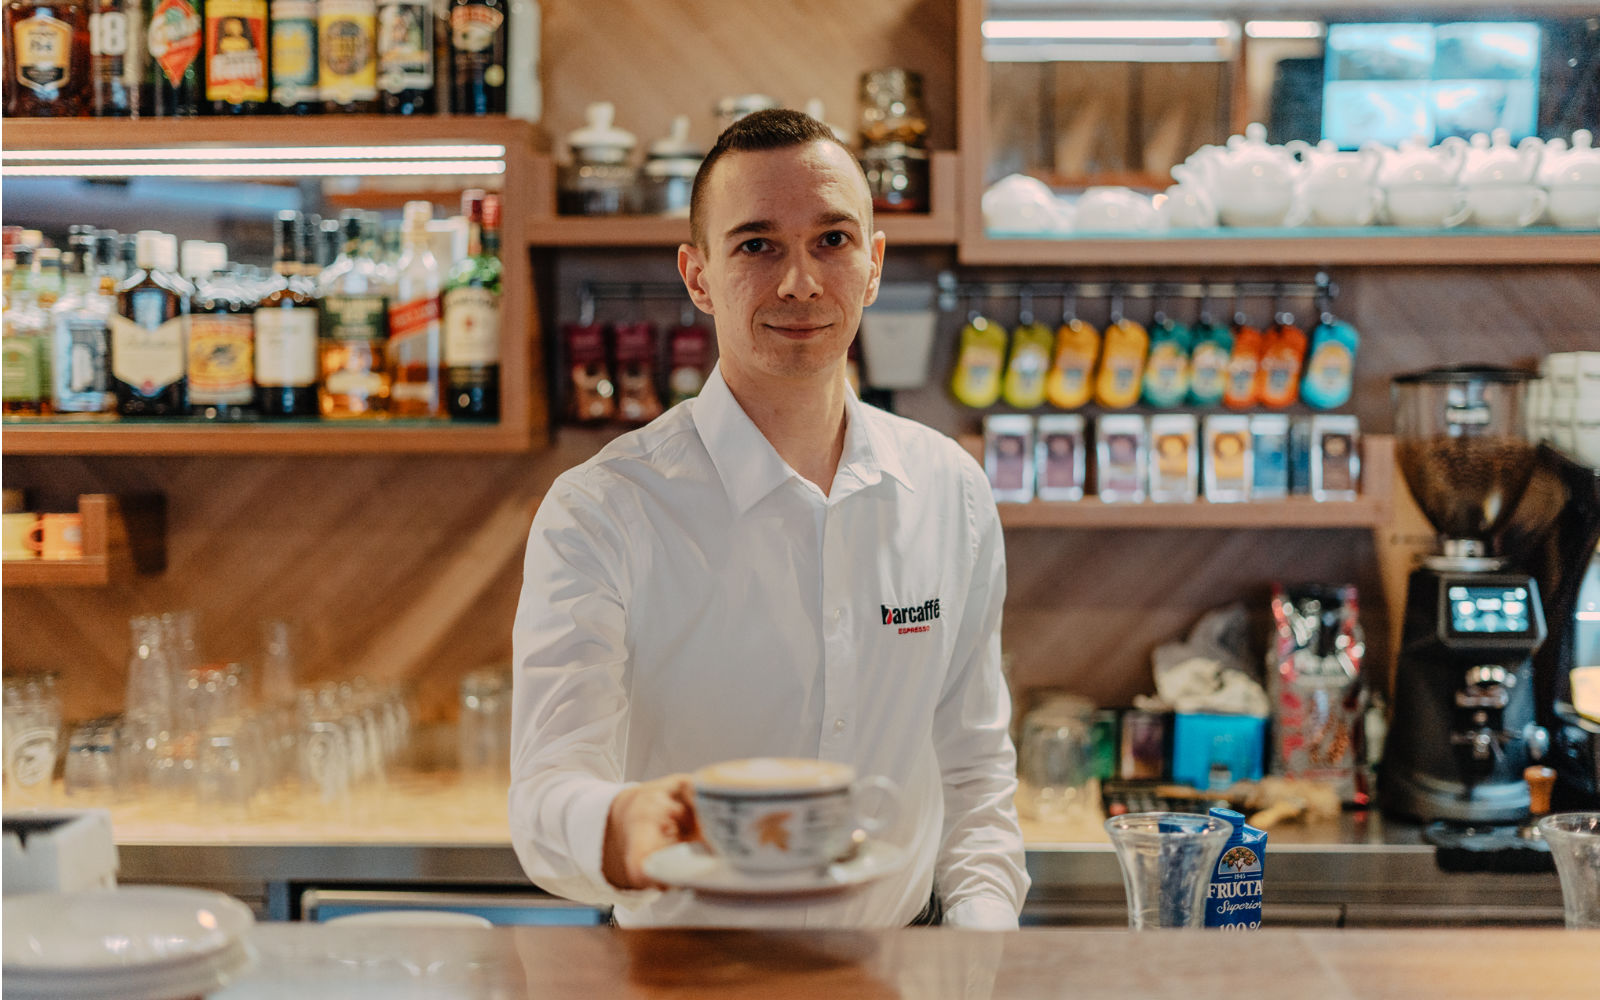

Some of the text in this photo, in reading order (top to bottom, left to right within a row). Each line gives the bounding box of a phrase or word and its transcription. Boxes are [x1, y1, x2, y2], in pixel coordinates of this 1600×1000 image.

[880, 598, 940, 625] barcaffé
[898, 626, 930, 634] ESPRESSO
[1206, 880, 1263, 899] FRUCTA
